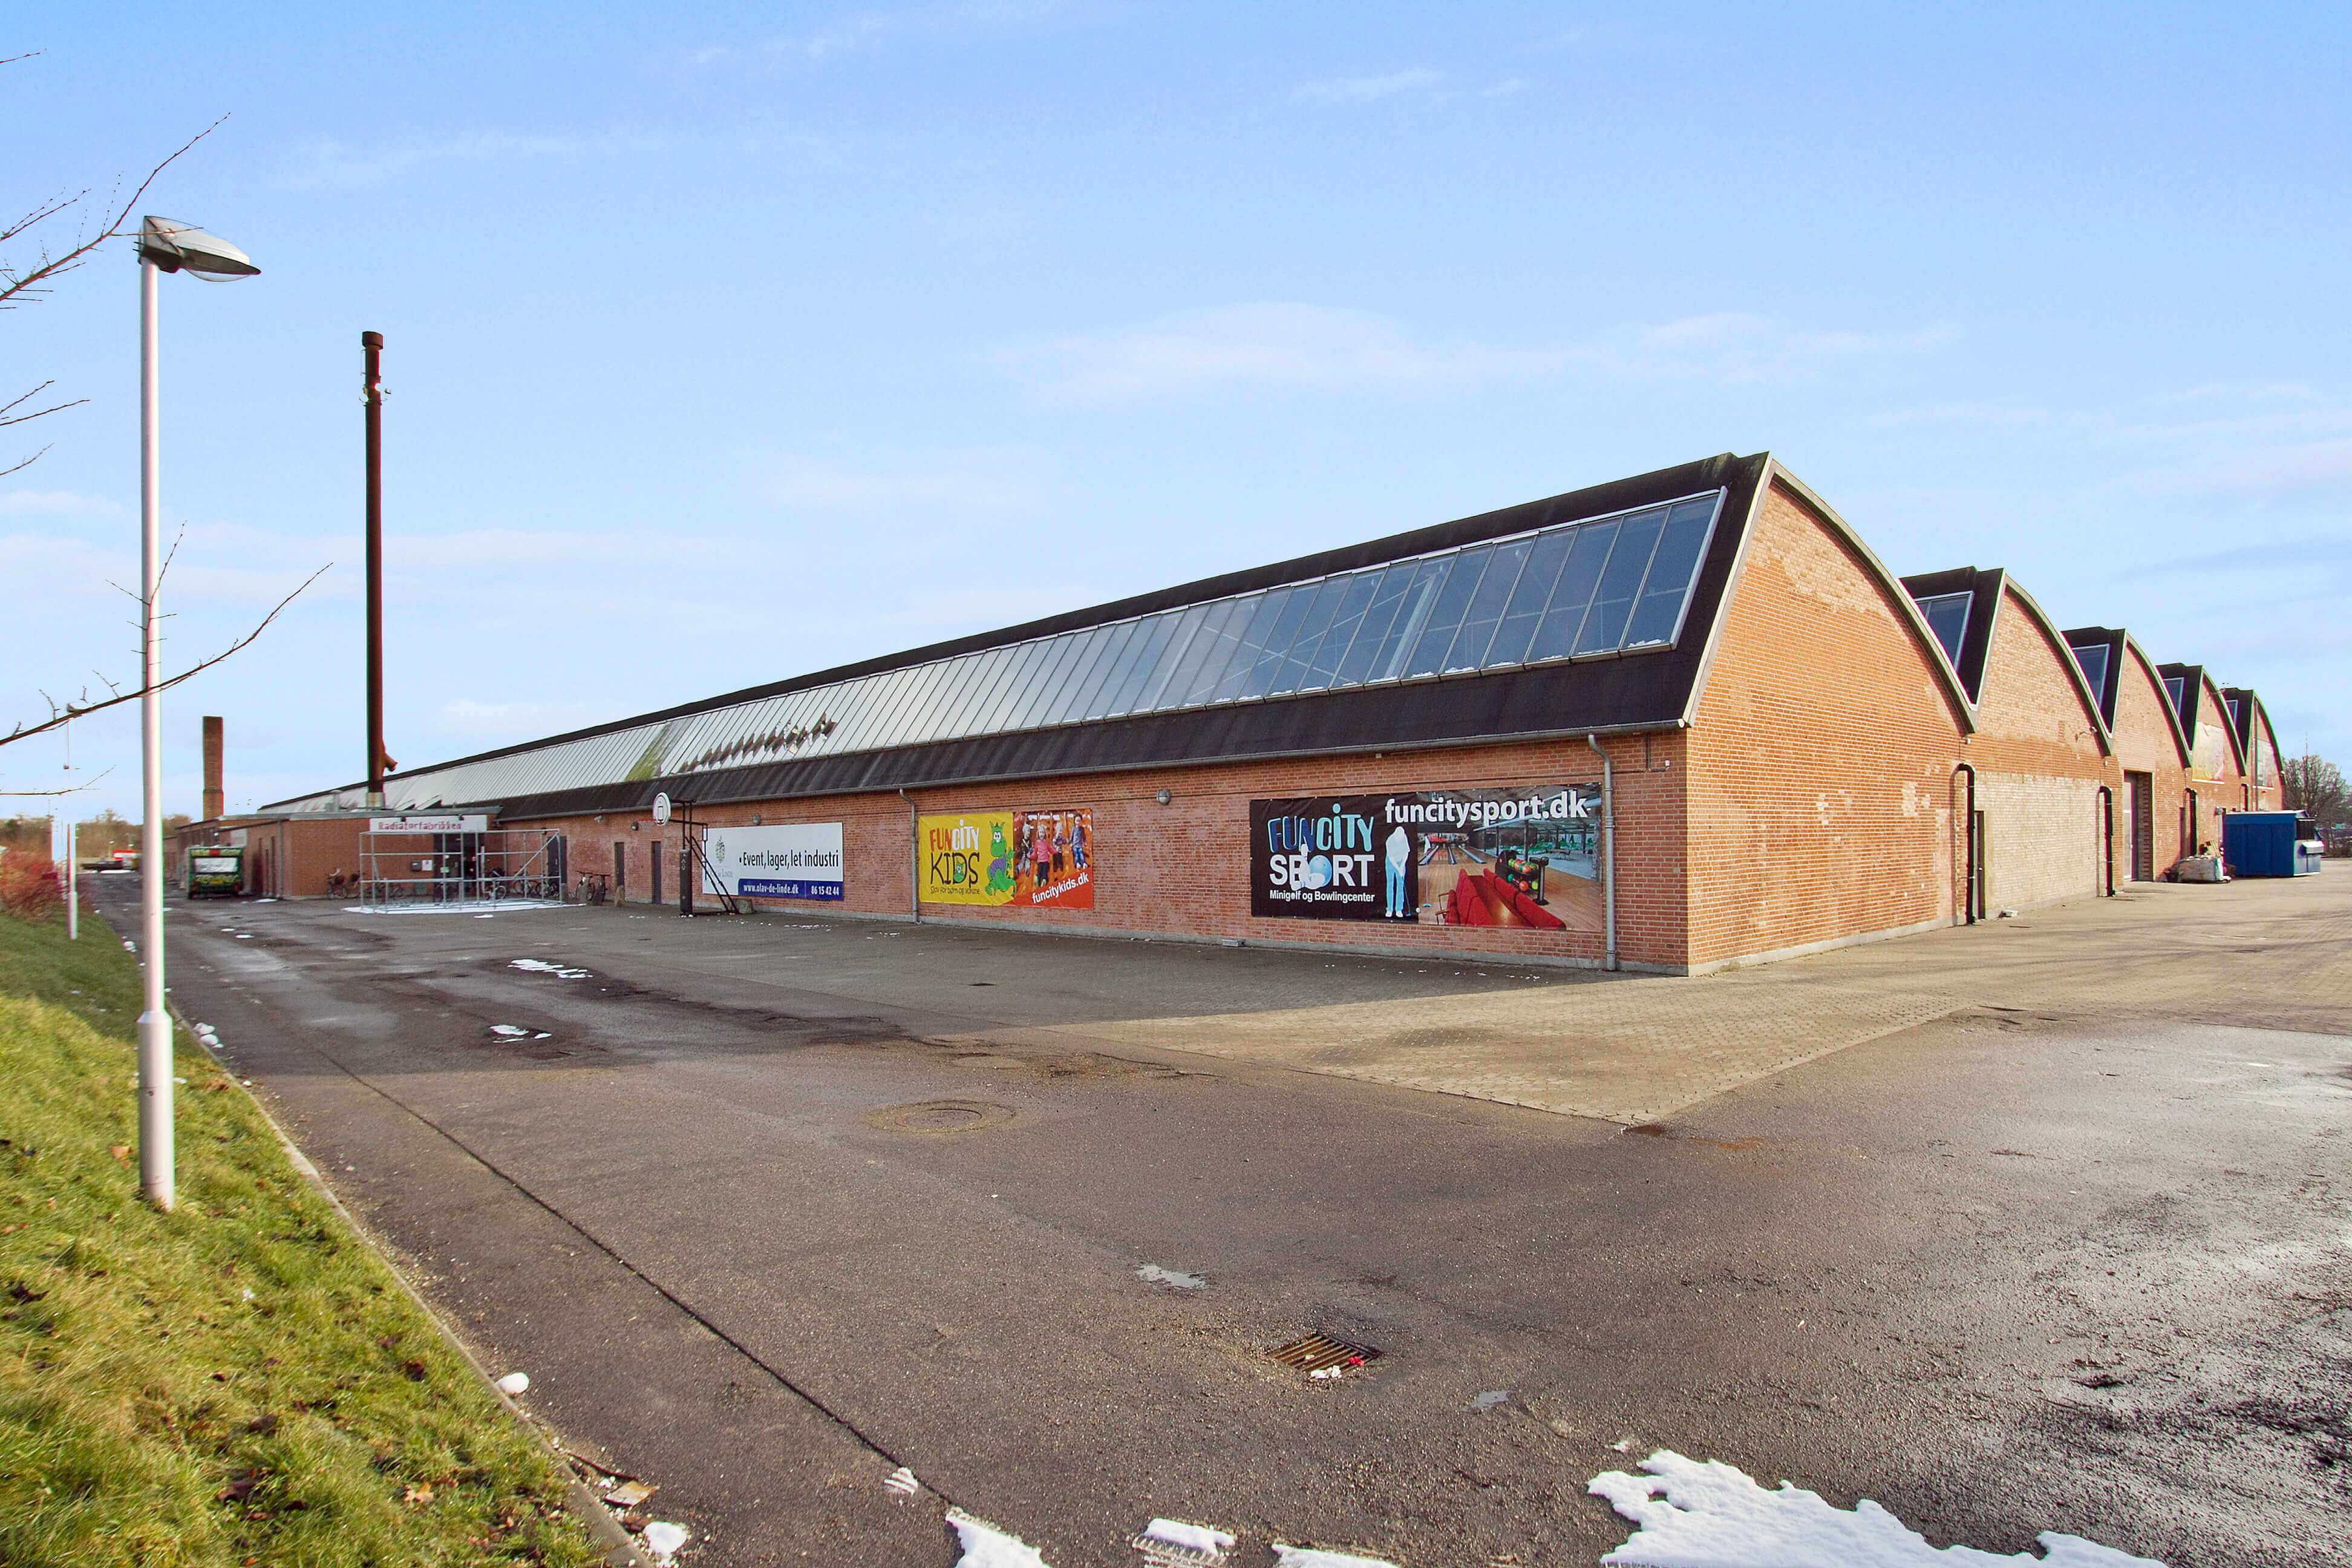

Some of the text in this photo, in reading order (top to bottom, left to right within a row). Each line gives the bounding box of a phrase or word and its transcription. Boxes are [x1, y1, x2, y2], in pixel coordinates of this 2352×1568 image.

[1385, 789, 1588, 829] funcitysport.dk
[743, 849, 839, 871] Event, lager, let industri
[930, 852, 980, 888] KIDS
[743, 883, 840, 896] www.olav-de-linde.dk 86 15 42 44
[1032, 872, 1089, 904] funcitykids.dk
[1269, 889, 1375, 904] Minigolf og Bowlingcenter
